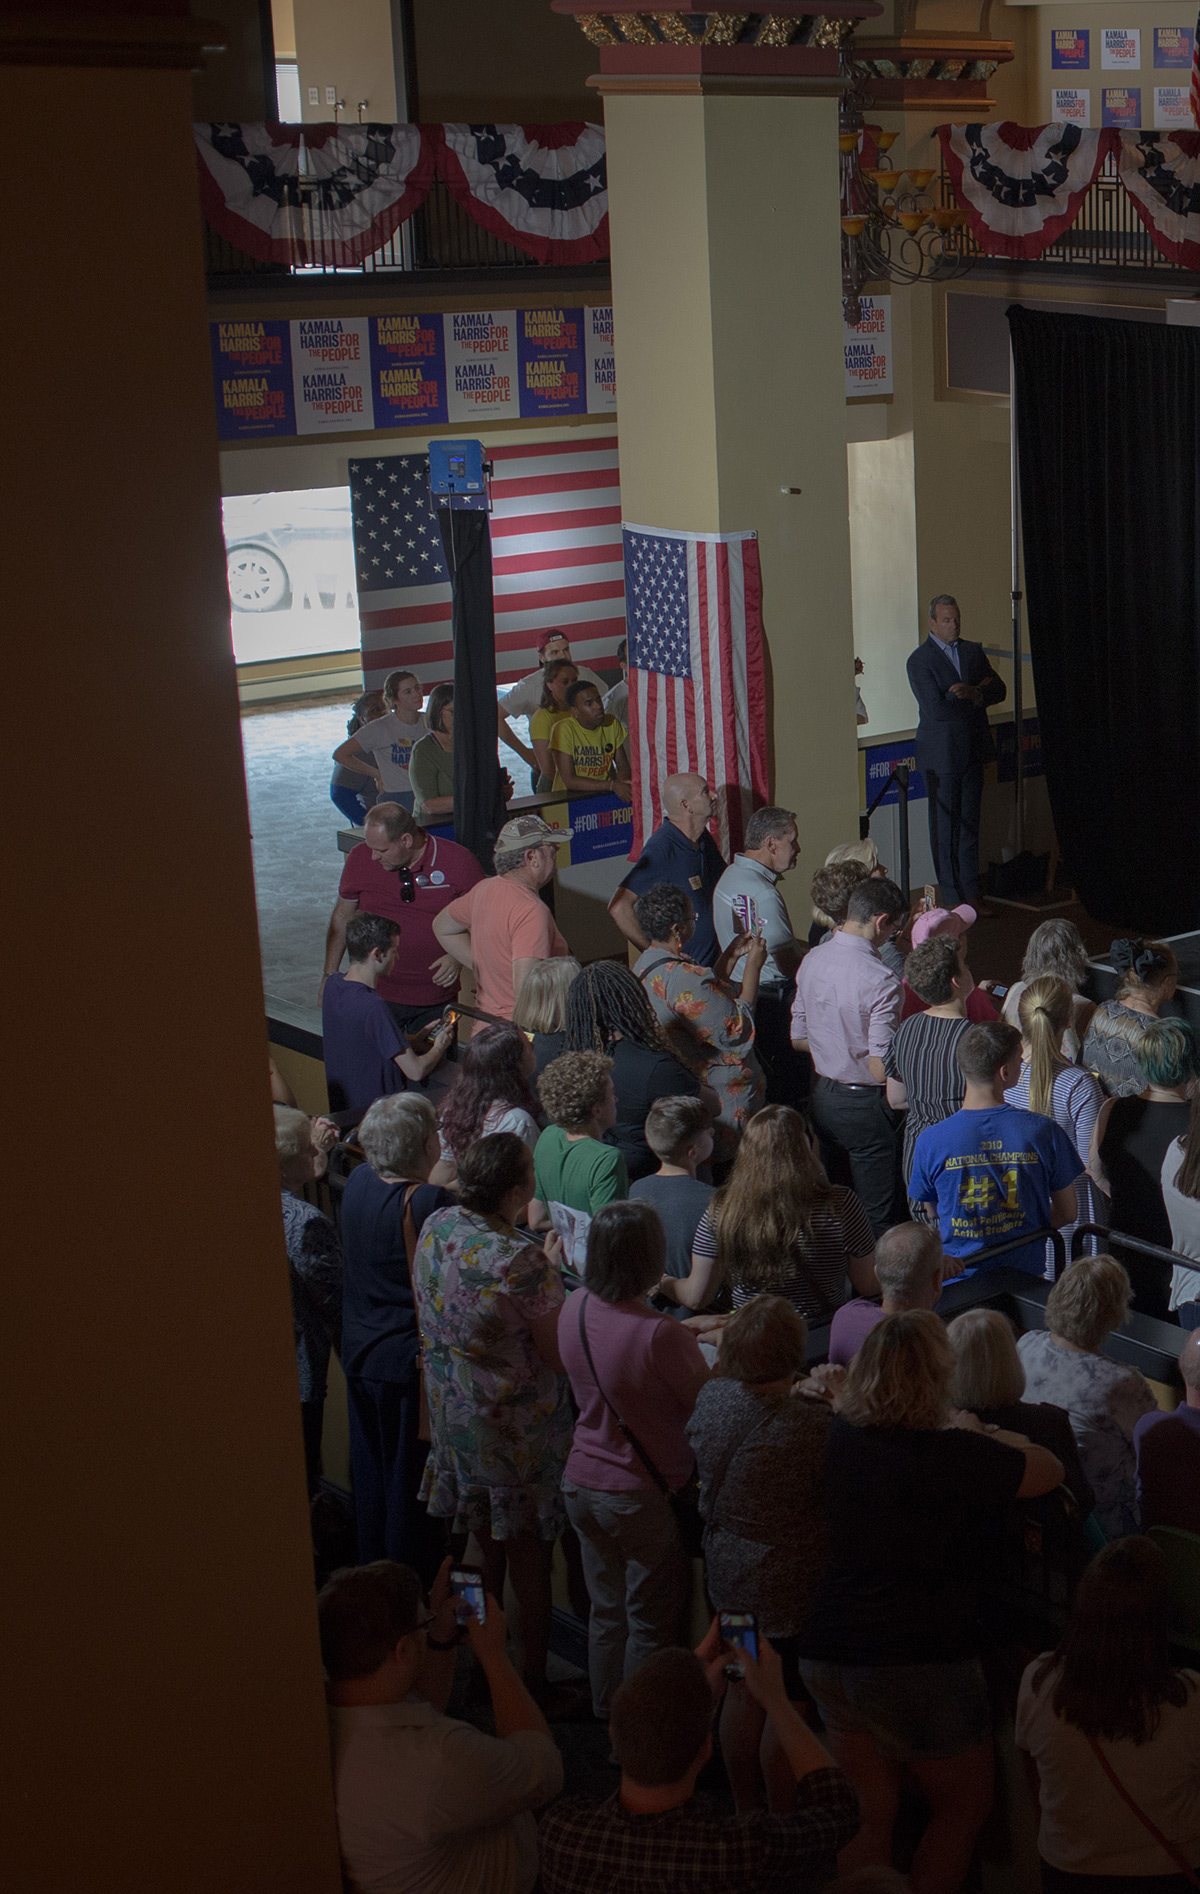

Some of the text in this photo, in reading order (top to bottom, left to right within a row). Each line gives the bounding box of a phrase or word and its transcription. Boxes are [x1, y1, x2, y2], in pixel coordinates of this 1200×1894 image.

[1106, 31, 1127, 39] KAMALA
[1106, 40, 1125, 48] HARRIS
[1116, 49, 1135, 58] PEOPLE
[1056, 91, 1077, 99] KAMALA
[1056, 100, 1075, 108] HARRIS
[1066, 108, 1085, 117] PEOPLE
[1168, 107, 1190, 116] PEOPLE
[453, 313, 493, 327] KAMALA
[524, 310, 565, 323] KAMALA
[593, 309, 613, 321] KAM
[871, 309, 884, 320] FOR
[219, 322, 265, 337] KAMALA
[300, 320, 343, 334] KAMALA
[377, 316, 420, 330] KAMALA
[525, 323, 577, 337] HARRIS FOR
[593, 322, 613, 334] HAR
[856, 321, 885, 333] PEOPLE
[378, 329, 435, 345] HARRIS FOR
[454, 326, 508, 341] HARRIS FOR
[220, 336, 282, 352] HARRIS FOR
[301, 334, 359, 348] HARRIS FOR
[461, 339, 509, 353] THE PEOPLE
[544, 335, 578, 350] PEOPLE
[309, 347, 360, 361] THE PEOPLE
[398, 342, 436, 357] PEOPLE
[241, 351, 283, 366] PEOPLE
[595, 358, 615, 370] KAM
[872, 356, 886, 368] FOR
[455, 364, 495, 378] KAMALA
[526, 360, 566, 374] KAMALA
[859, 368, 886, 380] PEOPLE
[303, 373, 346, 388] KAMALA
[380, 368, 422, 383] KAMALA
[526, 372, 578, 388] HARRIS FOR
[595, 371, 615, 383] HAR
[223, 378, 268, 393] KAMALA
[381, 381, 438, 397] HARRIS FOR
[456, 376, 510, 391] HARRIS FOR
[224, 391, 285, 408] HARRIS FOR
[304, 386, 362, 402] HARRIS FOR
[475, 389, 511, 404] PEOPLE
[545, 385, 579, 400] PEOPLE
[312, 400, 363, 414] THE PEOPLE
[400, 394, 439, 410] PEOPLE
[245, 405, 286, 420] PEOPLE
[574, 807, 633, 833] #FORTHEPEOP
[981, 1140, 1002, 1150] 2010
[945, 1152, 1038, 1167] NATIONAL CHAMPIONS
[958, 1168, 1020, 1210] #1
[952, 1211, 1026, 1227] Most Politically
[953, 1228, 984, 1238] Active
